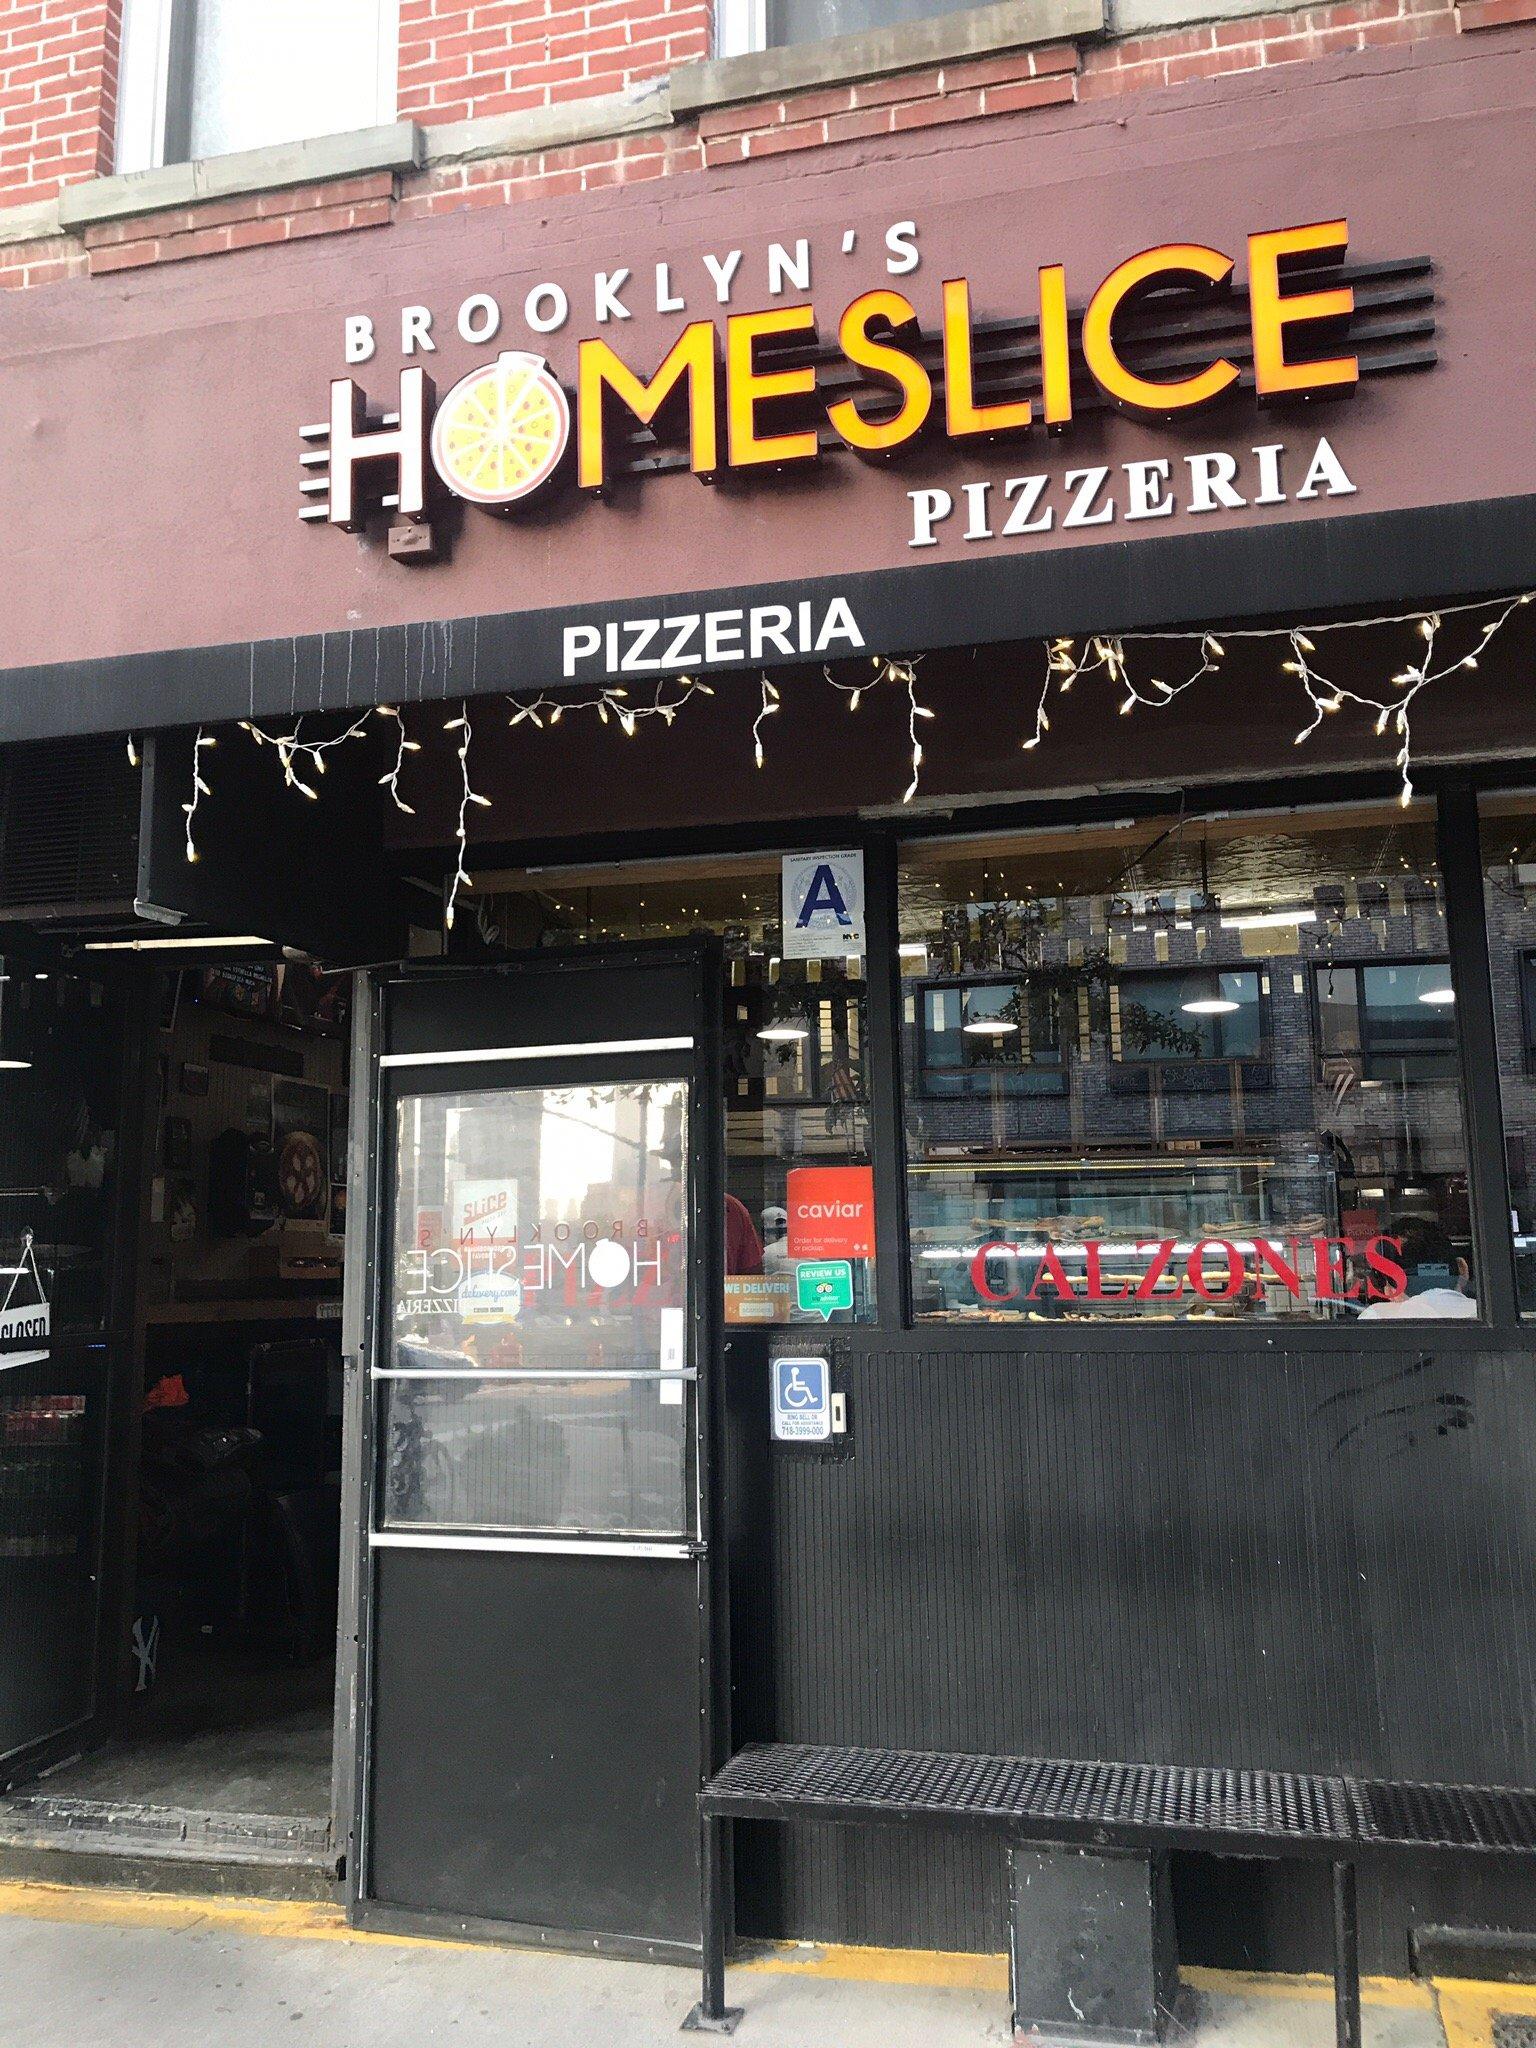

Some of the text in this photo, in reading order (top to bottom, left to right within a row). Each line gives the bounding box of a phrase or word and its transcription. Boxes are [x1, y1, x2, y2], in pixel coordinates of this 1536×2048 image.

[345, 219, 919, 363] BROOKLYN'S
[907, 436, 1357, 548] PIZZERIA
[562, 597, 866, 677] PIZZERIA
[795, 864, 852, 928] A
[797, 1200, 864, 1219] caviar
[822, 1237, 848, 1245] delivery
[724, 1283, 740, 1294] WE
[800, 1268, 847, 1278] REVIEW US
[969, 1235, 1407, 1302] CALZONES
[461, 1284, 518, 1303] delivery.com
